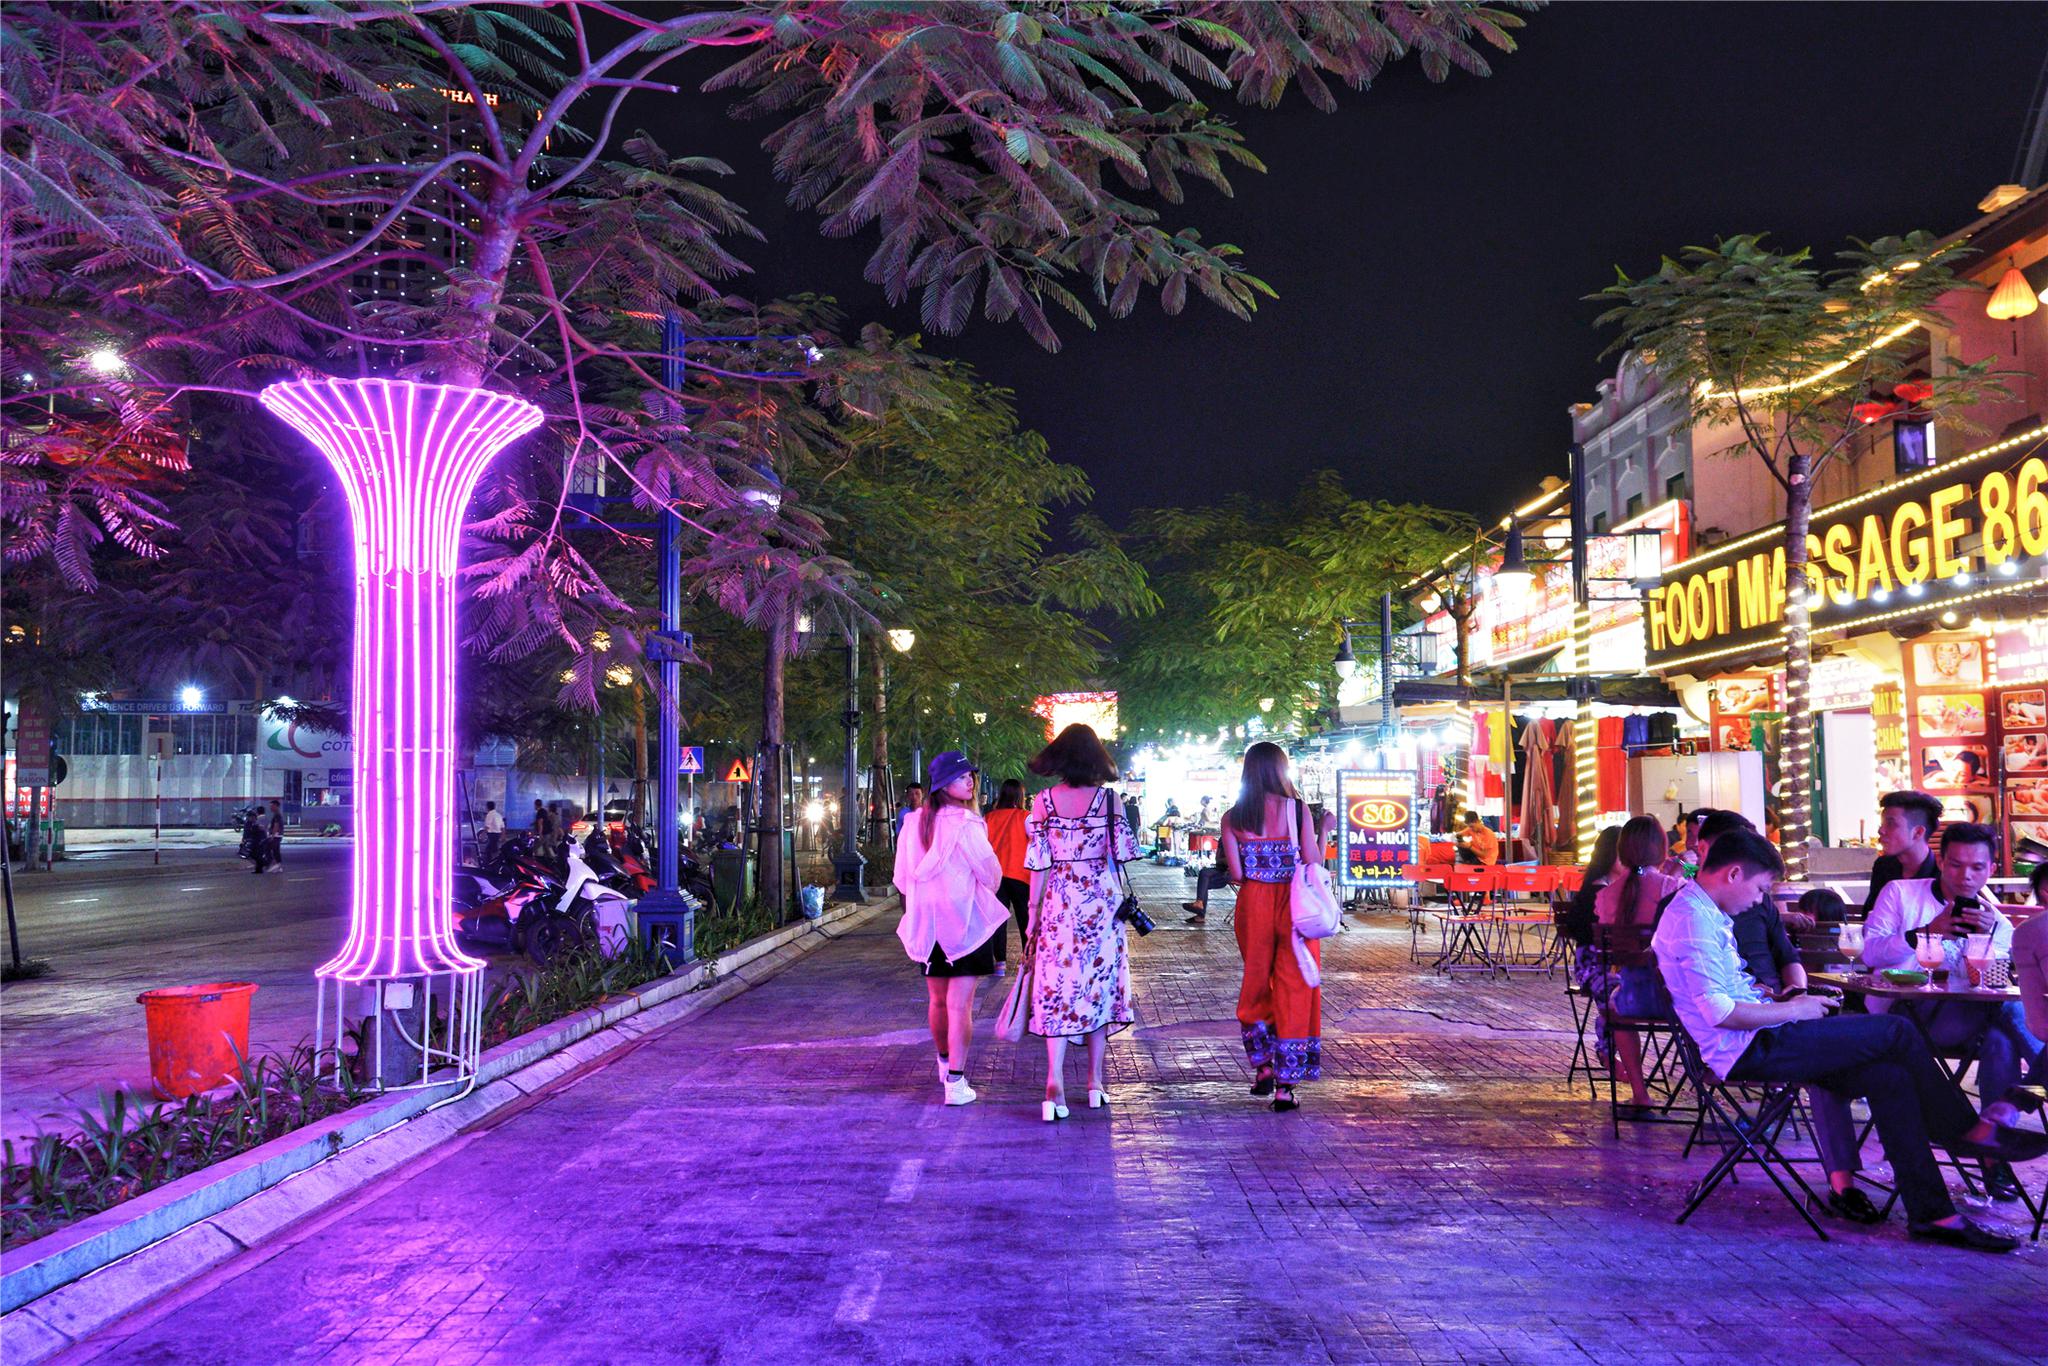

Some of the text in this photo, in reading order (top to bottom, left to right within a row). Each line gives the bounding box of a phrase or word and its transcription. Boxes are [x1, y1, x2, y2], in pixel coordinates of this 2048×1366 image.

[440, 88, 498, 106] THAH
[1649, 566, 1733, 650] FOOT
[1737, 484, 1973, 629] MASSAGE
[1980, 457, 2048, 565] 86
[137, 702, 167, 712] DRIVES
[170, 702, 181, 712] US
[183, 702, 224, 712] FORWARD
[1349, 829, 1367, 845] ĐÁ
[1376, 829, 1409, 845] MUỐI
